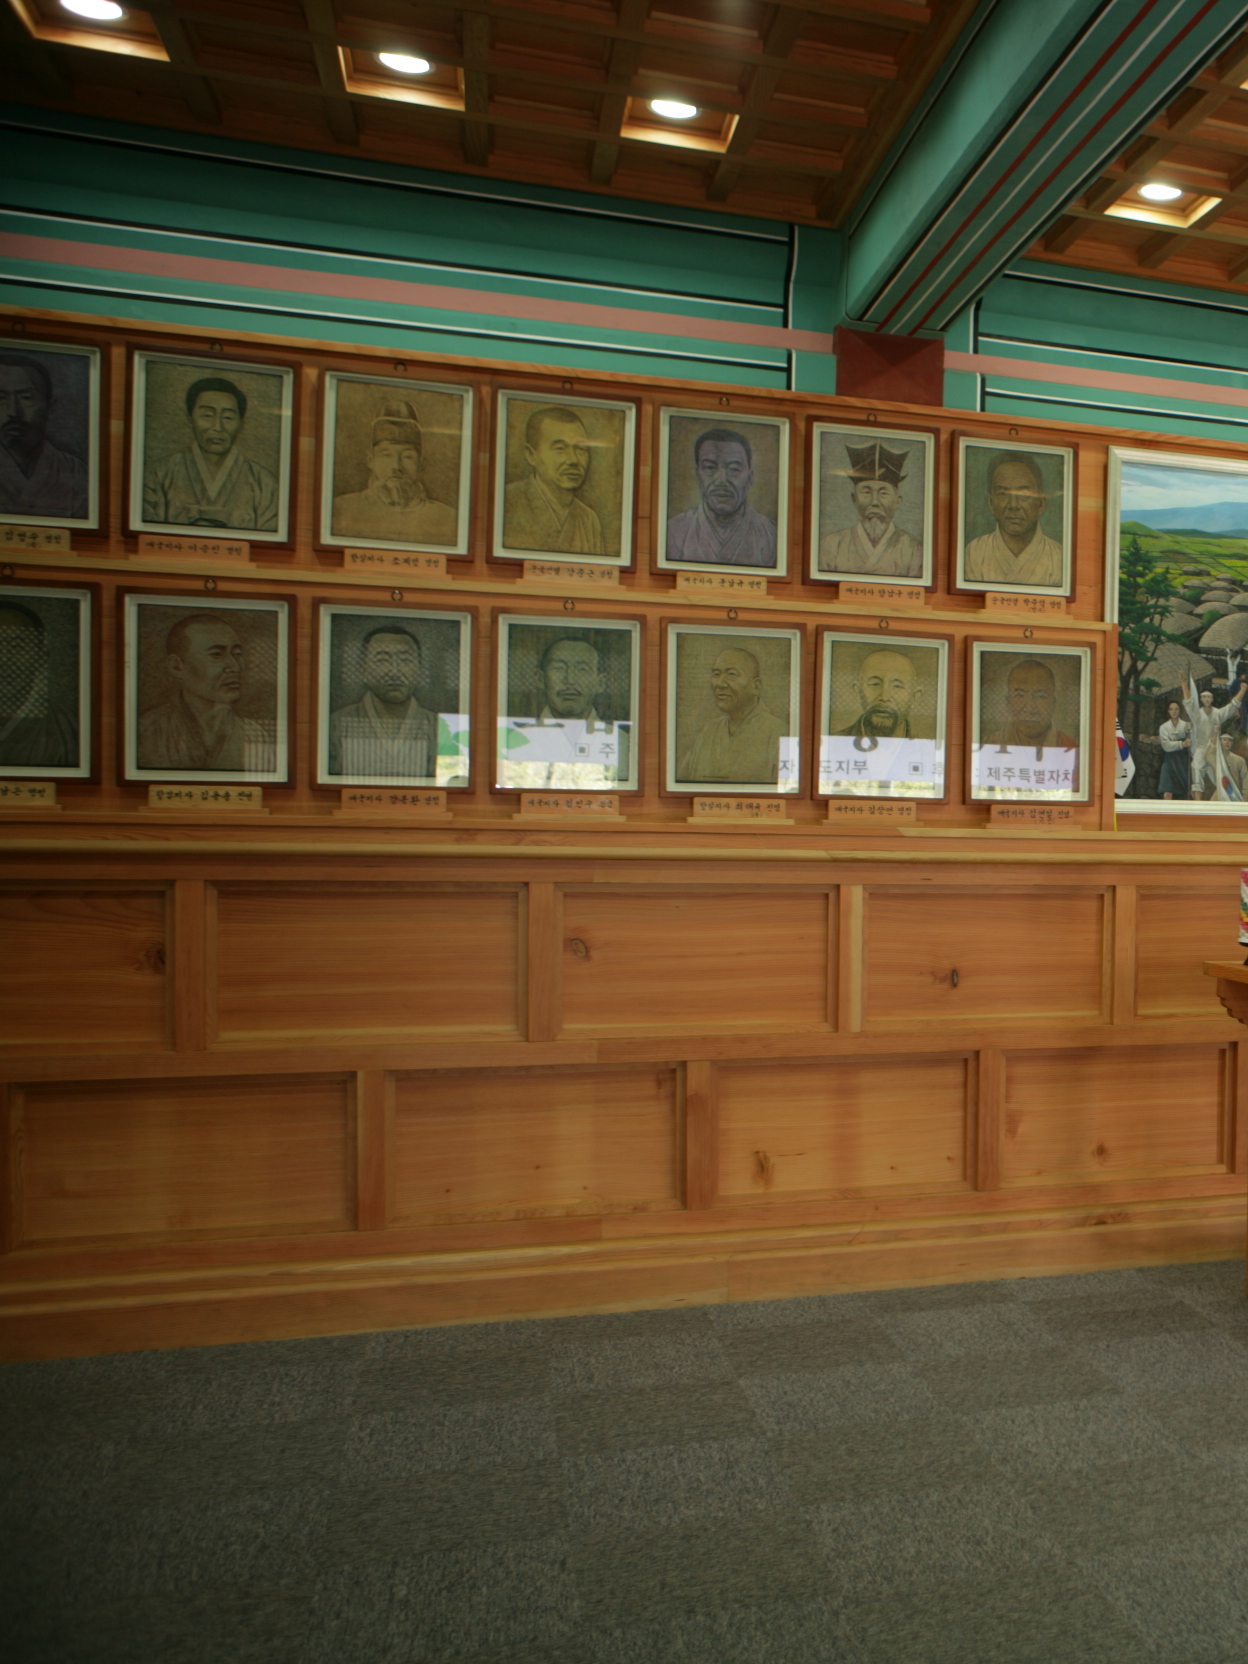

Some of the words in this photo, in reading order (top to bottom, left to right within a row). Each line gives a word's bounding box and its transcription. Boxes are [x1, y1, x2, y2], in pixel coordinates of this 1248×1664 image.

[845, 587, 875, 597] 애국지사
[878, 588, 904, 598] 양남구
[835, 805, 864, 815] 애국지사
[868, 805, 893, 816] 김상언
